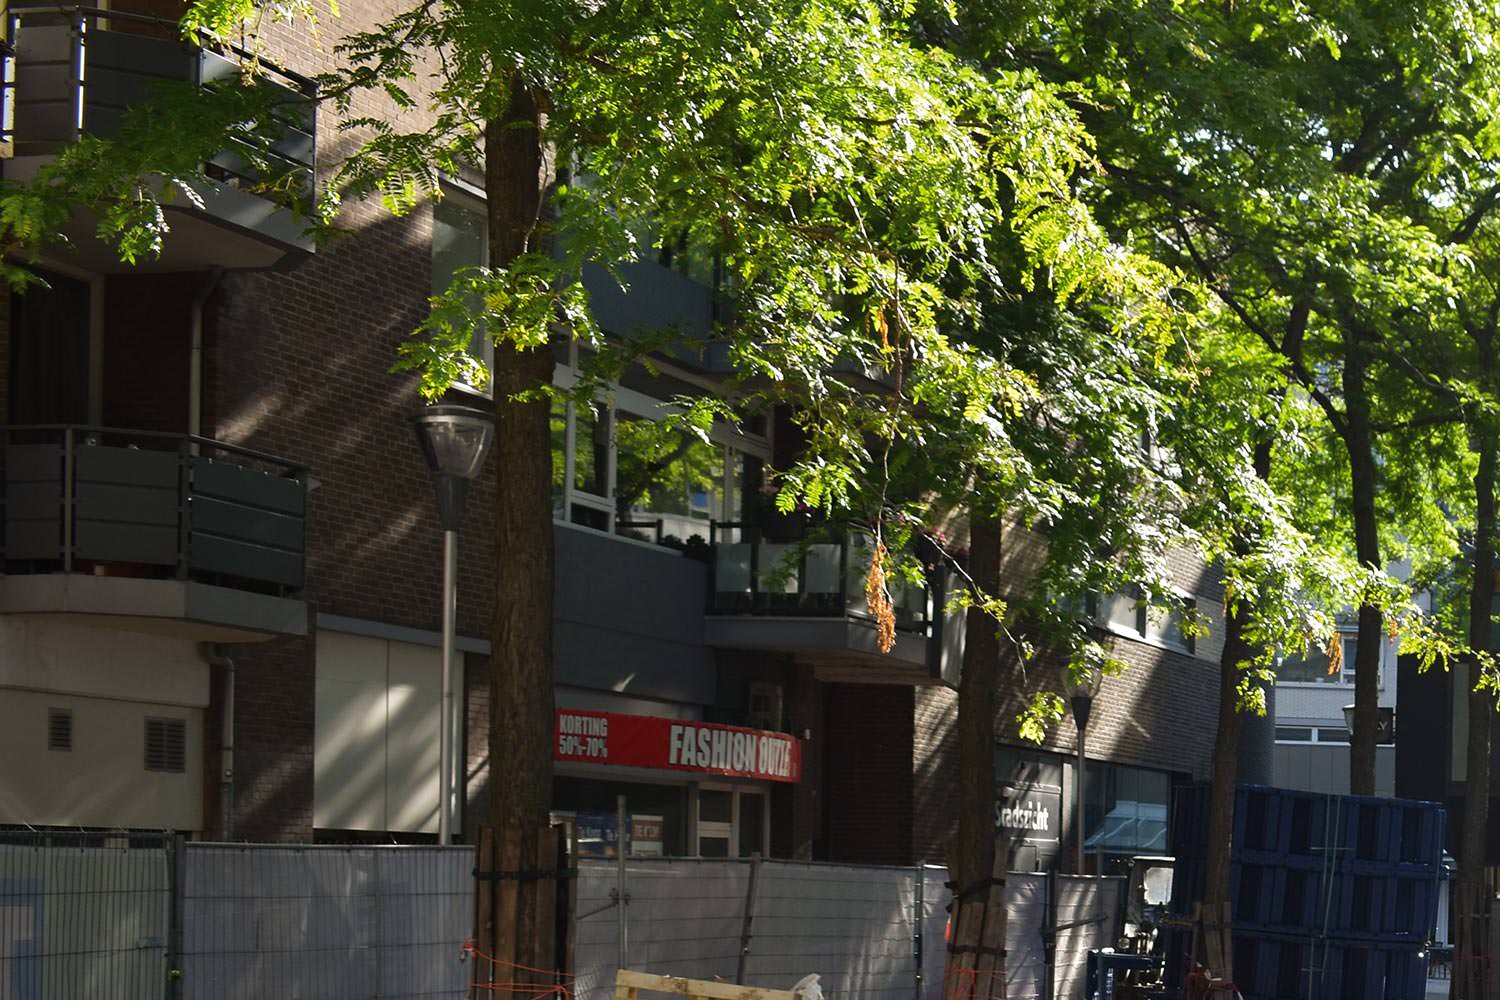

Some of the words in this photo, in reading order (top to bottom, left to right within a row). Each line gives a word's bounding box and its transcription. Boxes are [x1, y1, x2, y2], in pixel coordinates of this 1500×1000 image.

[560, 715, 608, 737] KORTING
[560, 735, 608, 758] 50%-70%
[669, 725, 757, 773] FASHION
